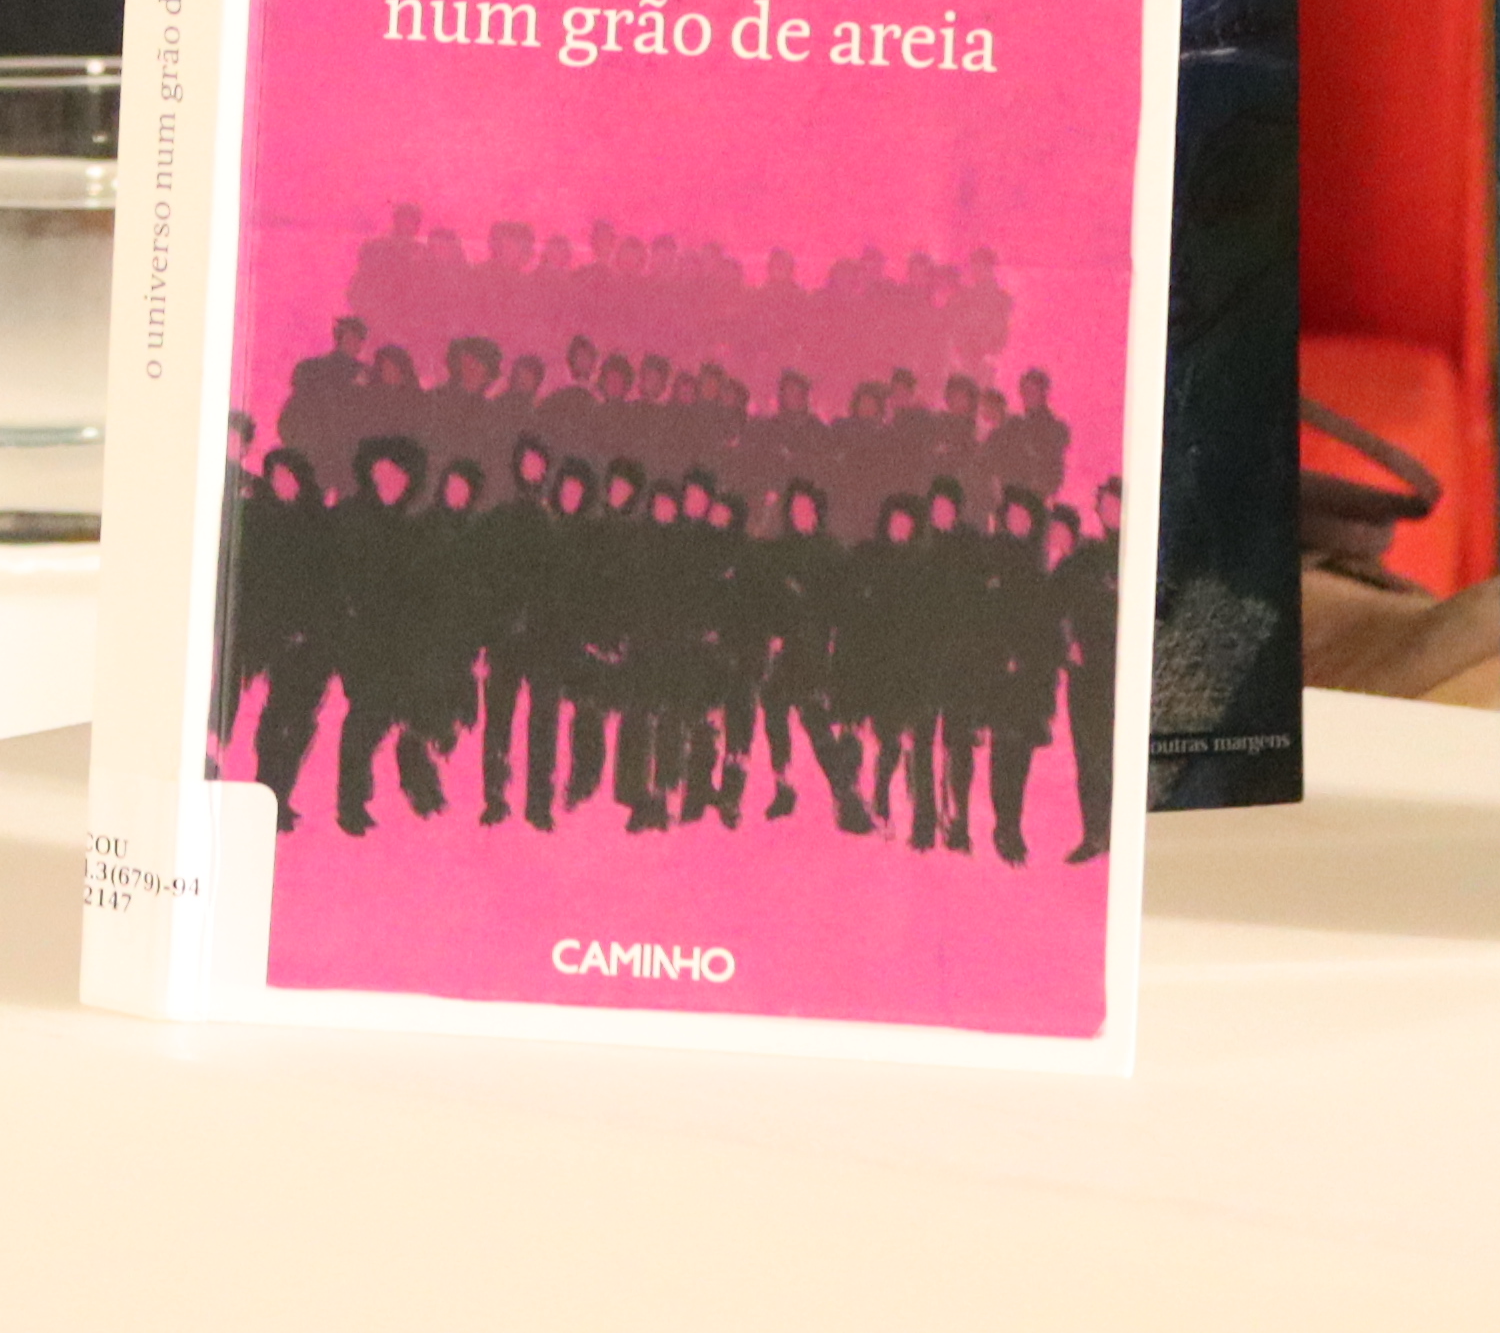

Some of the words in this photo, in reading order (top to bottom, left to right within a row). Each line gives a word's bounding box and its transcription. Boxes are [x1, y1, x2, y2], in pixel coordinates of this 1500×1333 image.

[157, 25, 184, 103] grão
[731, 0, 811, 62] de
[829, 11, 998, 73] areia
[155, 112, 177, 191] num
[143, 201, 171, 350] universo
[146, 359, 163, 380] o
[1150, 735, 1208, 754] outras
[1213, 733, 1291, 757] margens
[551, 938, 736, 983] CAMINHO
